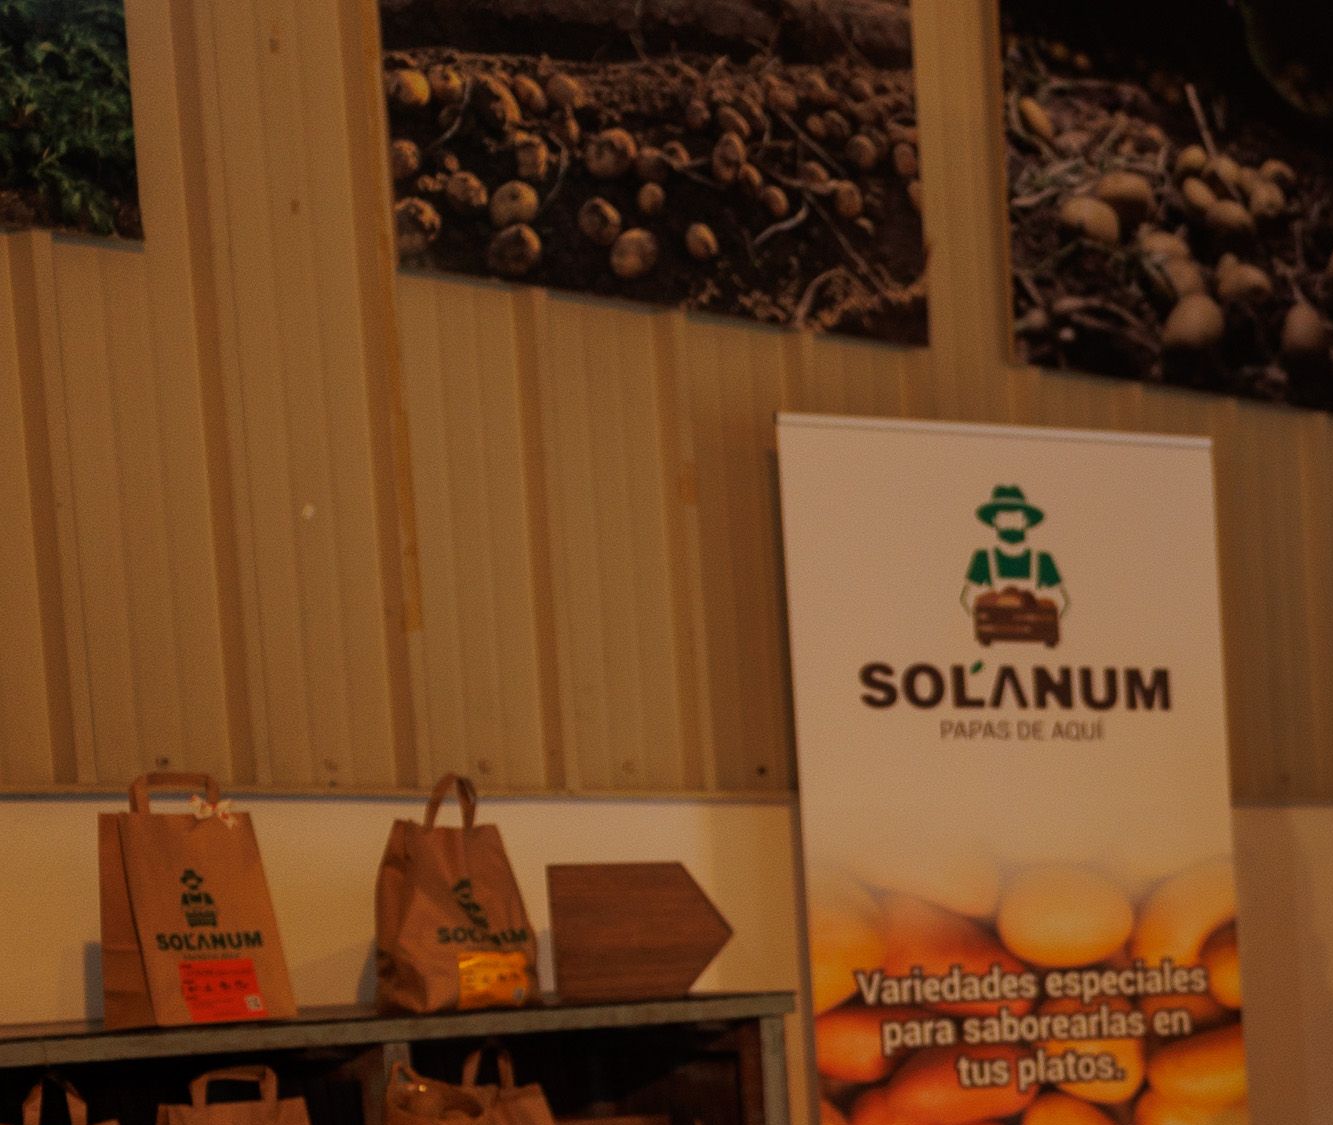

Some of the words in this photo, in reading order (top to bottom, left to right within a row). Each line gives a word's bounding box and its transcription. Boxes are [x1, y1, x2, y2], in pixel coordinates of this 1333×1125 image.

[940, 720, 1009, 741] PAPAS
[1017, 721, 1044, 740] DE
[855, 964, 1038, 1005] Variedades
[1045, 957, 1208, 1003] especiales
[882, 1017, 956, 1055] para
[963, 1004, 1146, 1043] saborearlas
[1153, 1008, 1192, 1035] en
[957, 1056, 1010, 1088] tus
[1018, 1049, 1126, 1091] platos.
